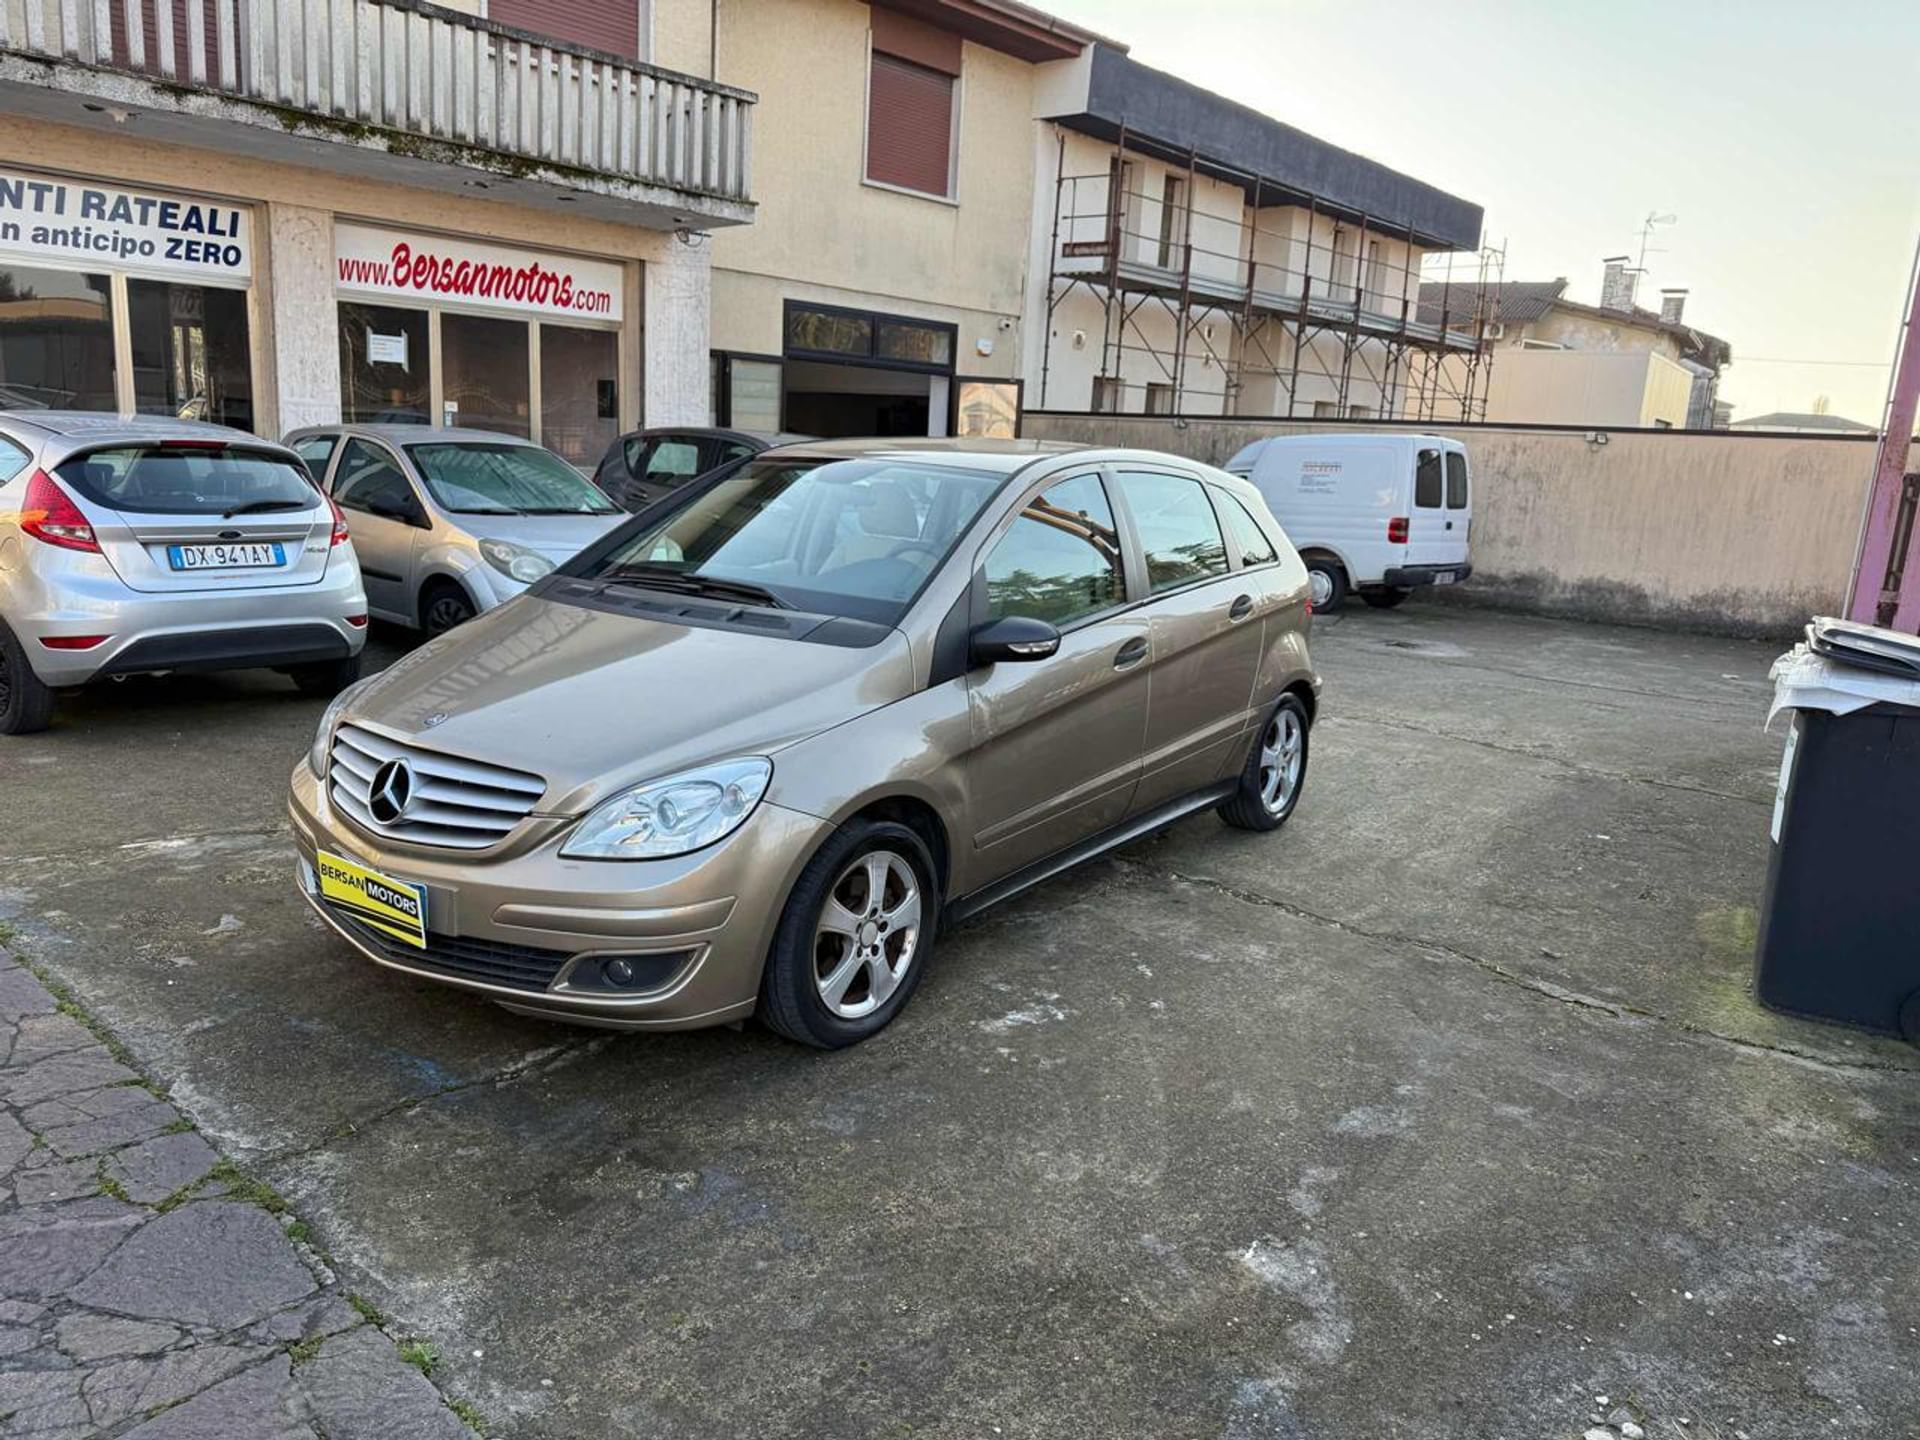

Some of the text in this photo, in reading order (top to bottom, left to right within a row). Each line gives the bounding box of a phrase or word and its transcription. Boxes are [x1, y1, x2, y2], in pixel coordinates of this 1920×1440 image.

[81, 190, 239, 237] RATEALI
[31, 226, 155, 258] anticipo
[165, 237, 242, 267] ZERO
[338, 243, 610, 313] www.Bersanmotors.com
[184, 545, 270, 566] DX 941AY
[320, 863, 417, 915] BERSAN MOTORS
